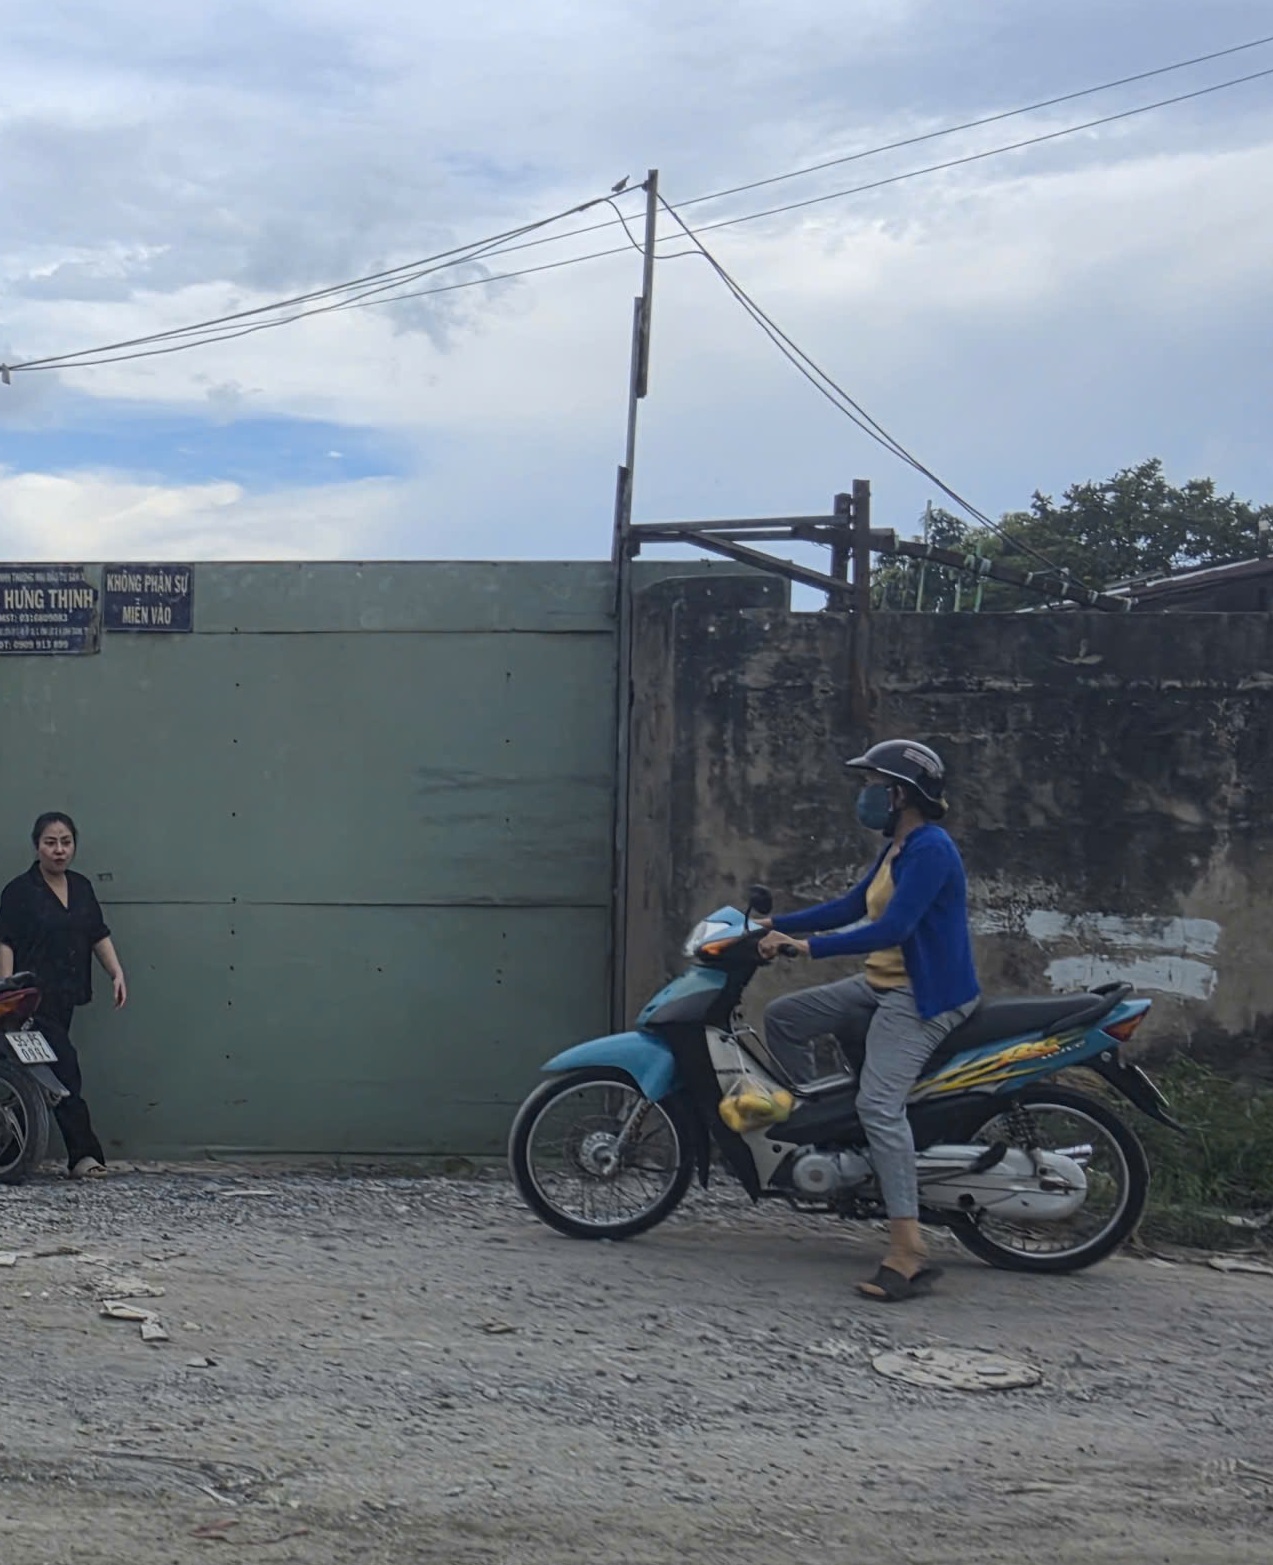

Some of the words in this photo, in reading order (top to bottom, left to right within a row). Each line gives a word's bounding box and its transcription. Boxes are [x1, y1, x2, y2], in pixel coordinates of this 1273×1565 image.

[107, 569, 142, 593] KHÔNG
[144, 571, 172, 596] PHẬN
[175, 571, 189, 596] SỰ
[3, 586, 45, 609] HƯNG
[48, 589, 94, 614] THỊNH
[122, 598, 148, 625] MIỄN
[150, 602, 172, 624] VÀO
